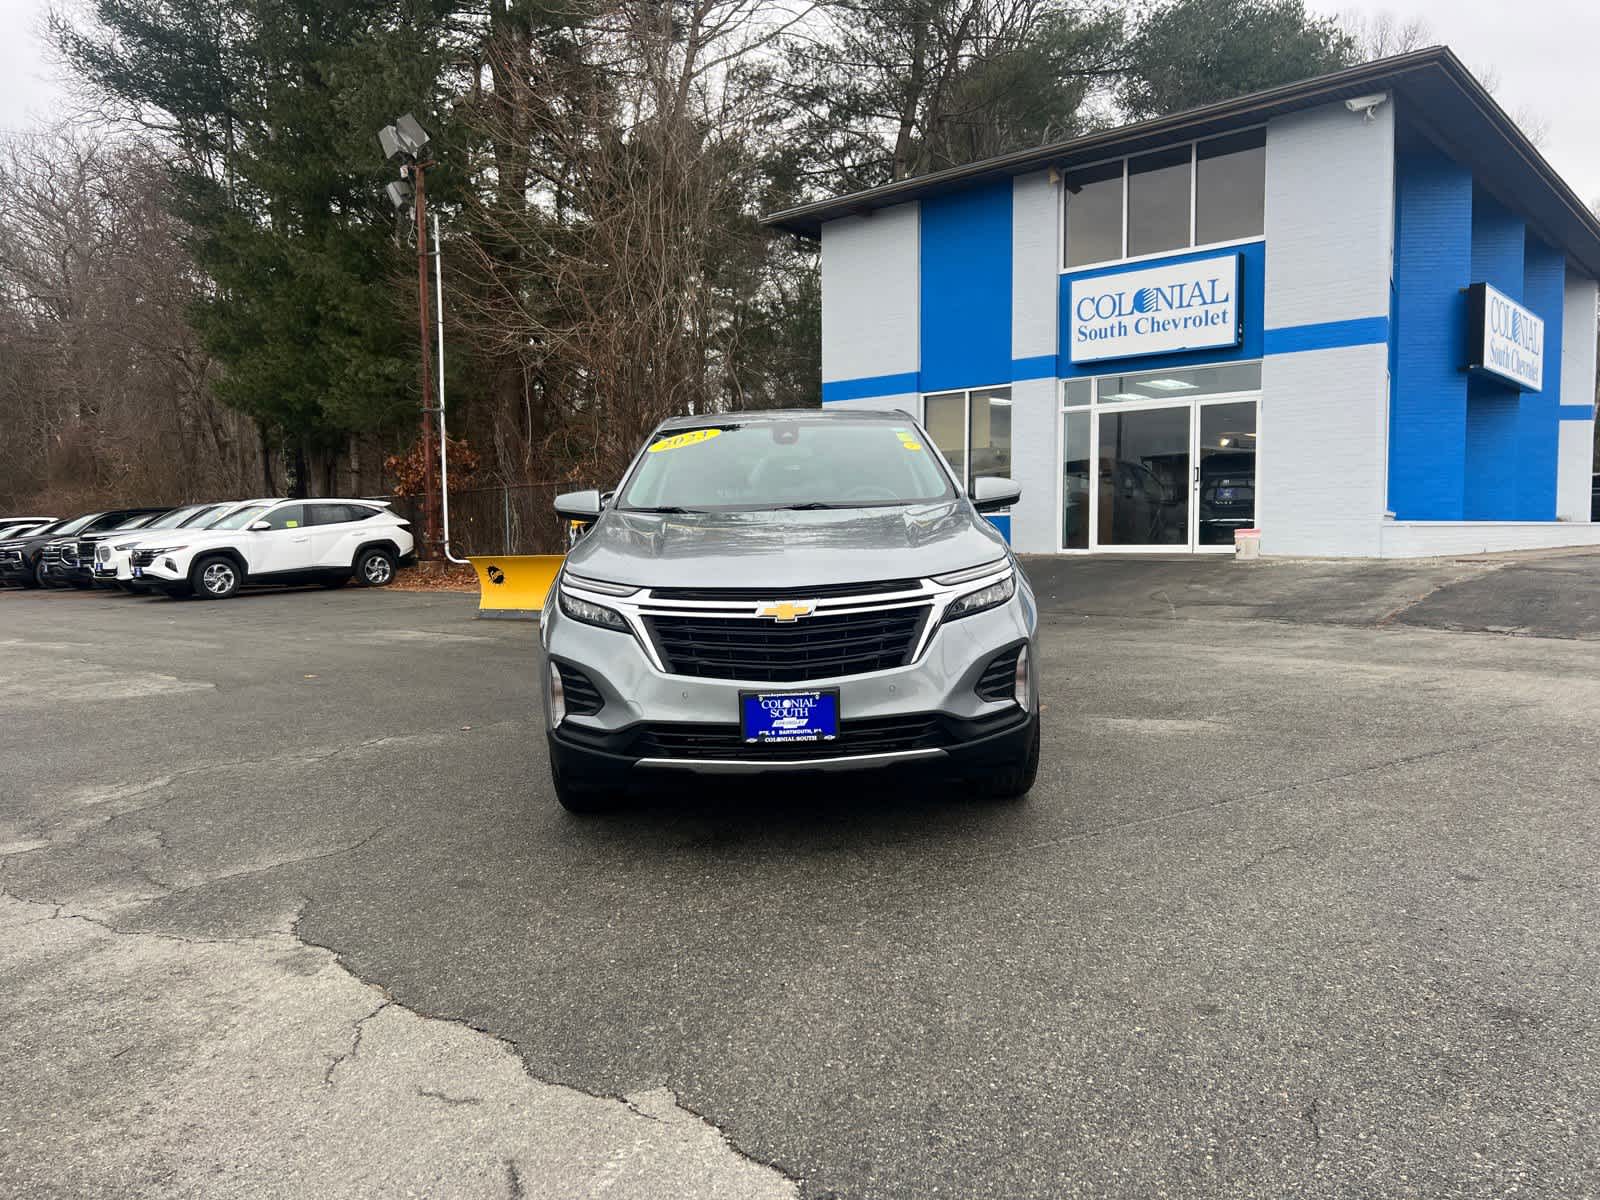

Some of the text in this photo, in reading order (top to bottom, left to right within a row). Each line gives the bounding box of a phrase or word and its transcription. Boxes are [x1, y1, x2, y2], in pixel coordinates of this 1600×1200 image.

[1076, 278, 1230, 322] COLONIAL
[1077, 309, 1229, 343] South Chevrolet
[761, 698, 817, 710] COLONIAL
[770, 707, 809, 718] SOUTH
